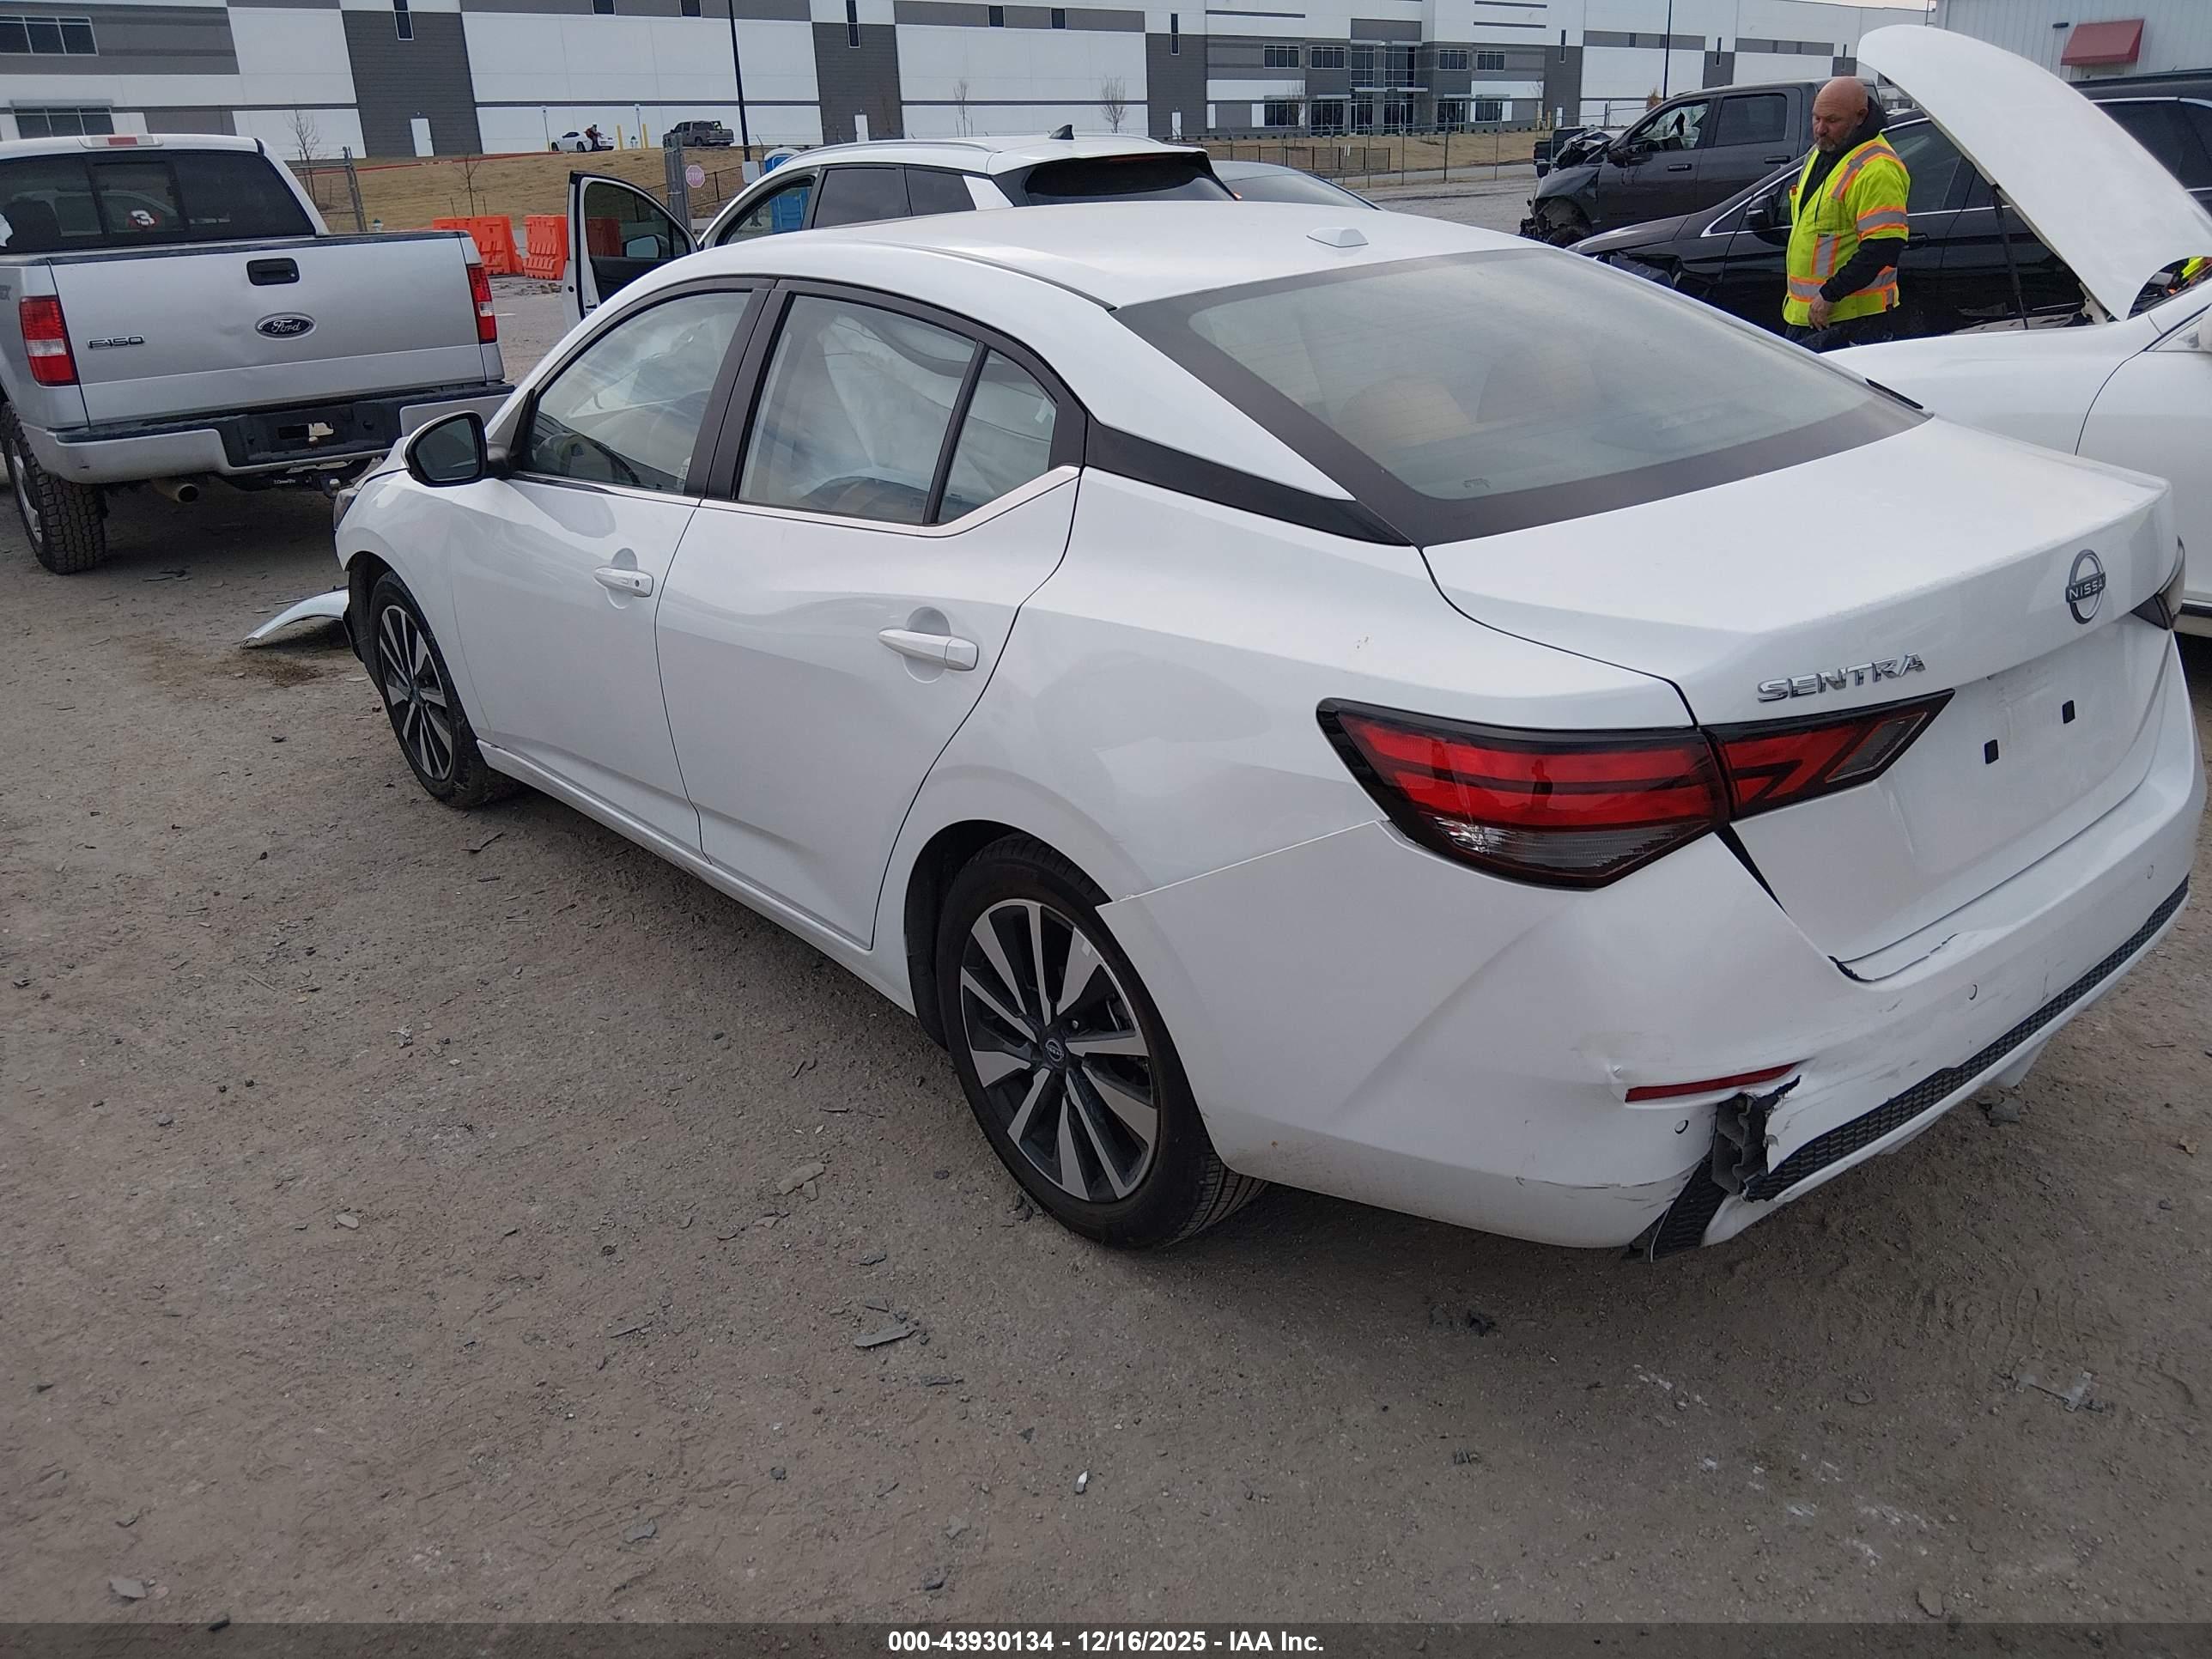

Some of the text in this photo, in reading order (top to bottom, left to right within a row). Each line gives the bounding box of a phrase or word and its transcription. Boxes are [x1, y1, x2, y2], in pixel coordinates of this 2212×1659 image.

[688, 172, 703, 181] STOP
[270, 319, 301, 333] Ford
[1758, 653, 1926, 703] SENTRA
